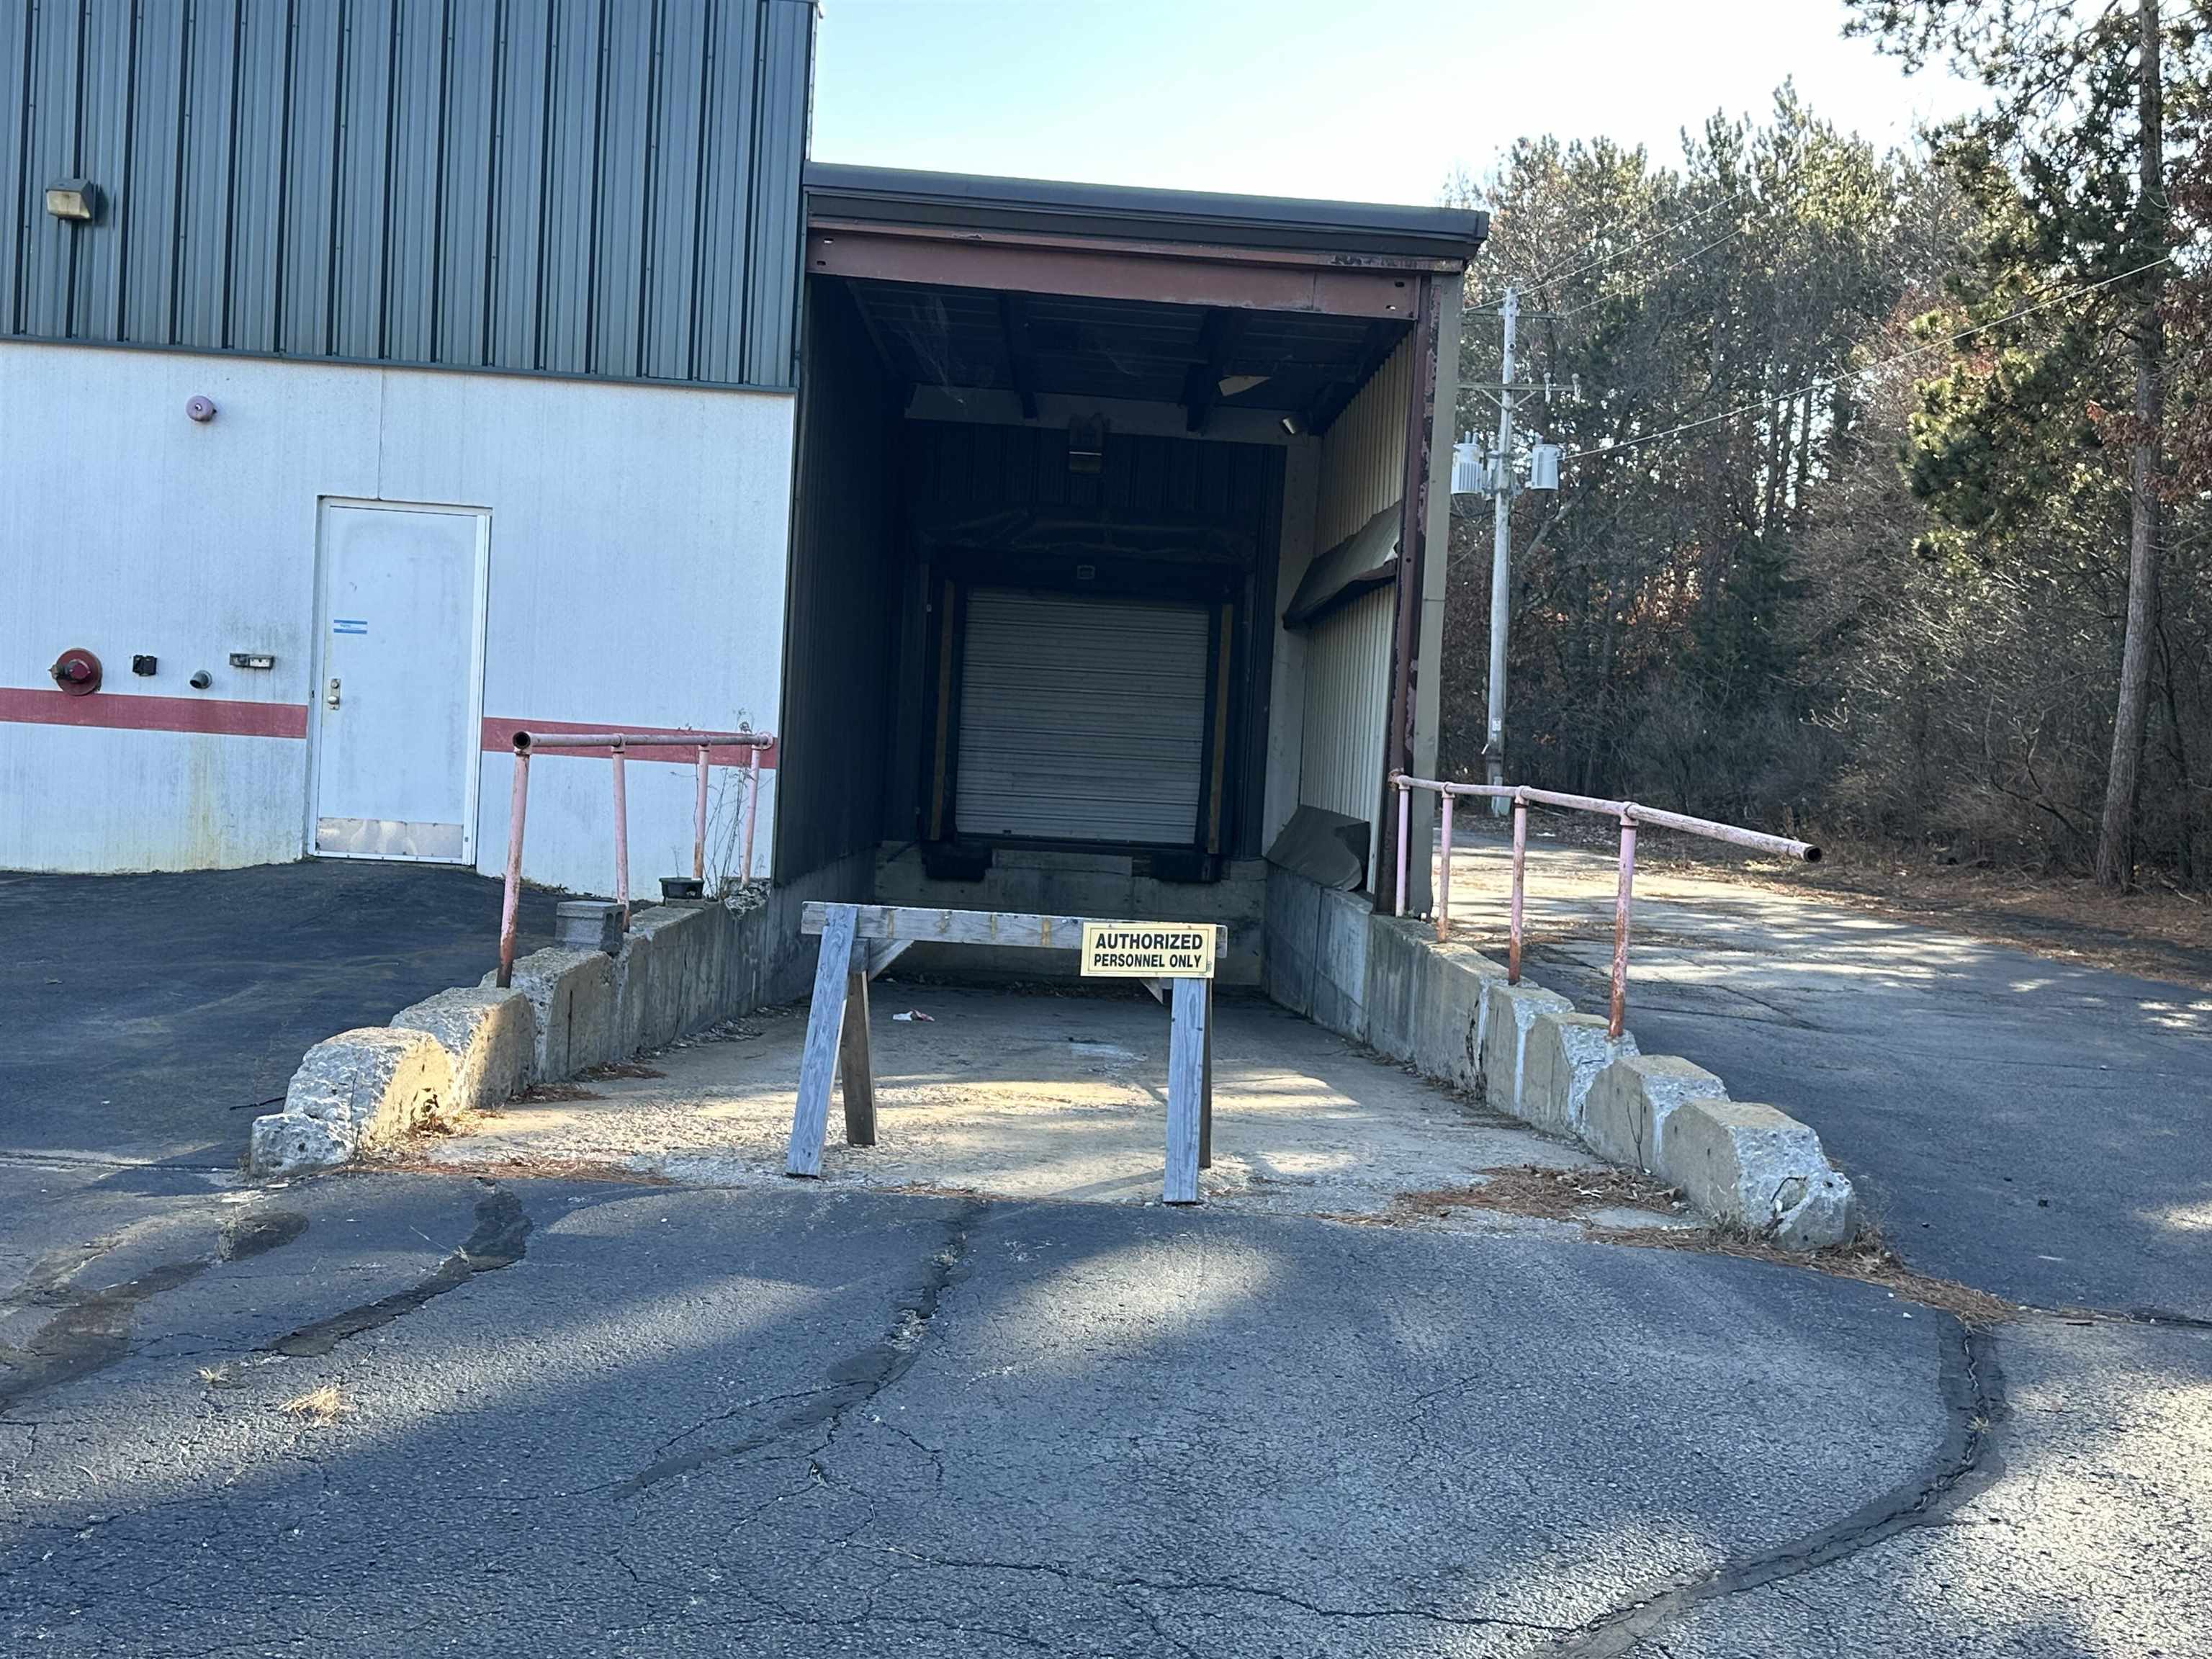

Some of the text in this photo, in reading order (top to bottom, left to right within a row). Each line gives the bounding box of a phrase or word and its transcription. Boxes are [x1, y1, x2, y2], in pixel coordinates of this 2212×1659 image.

[1095, 933, 1203, 950] AUTHORIZED
[1094, 954, 1202, 968] PERSONNEL ONLY
